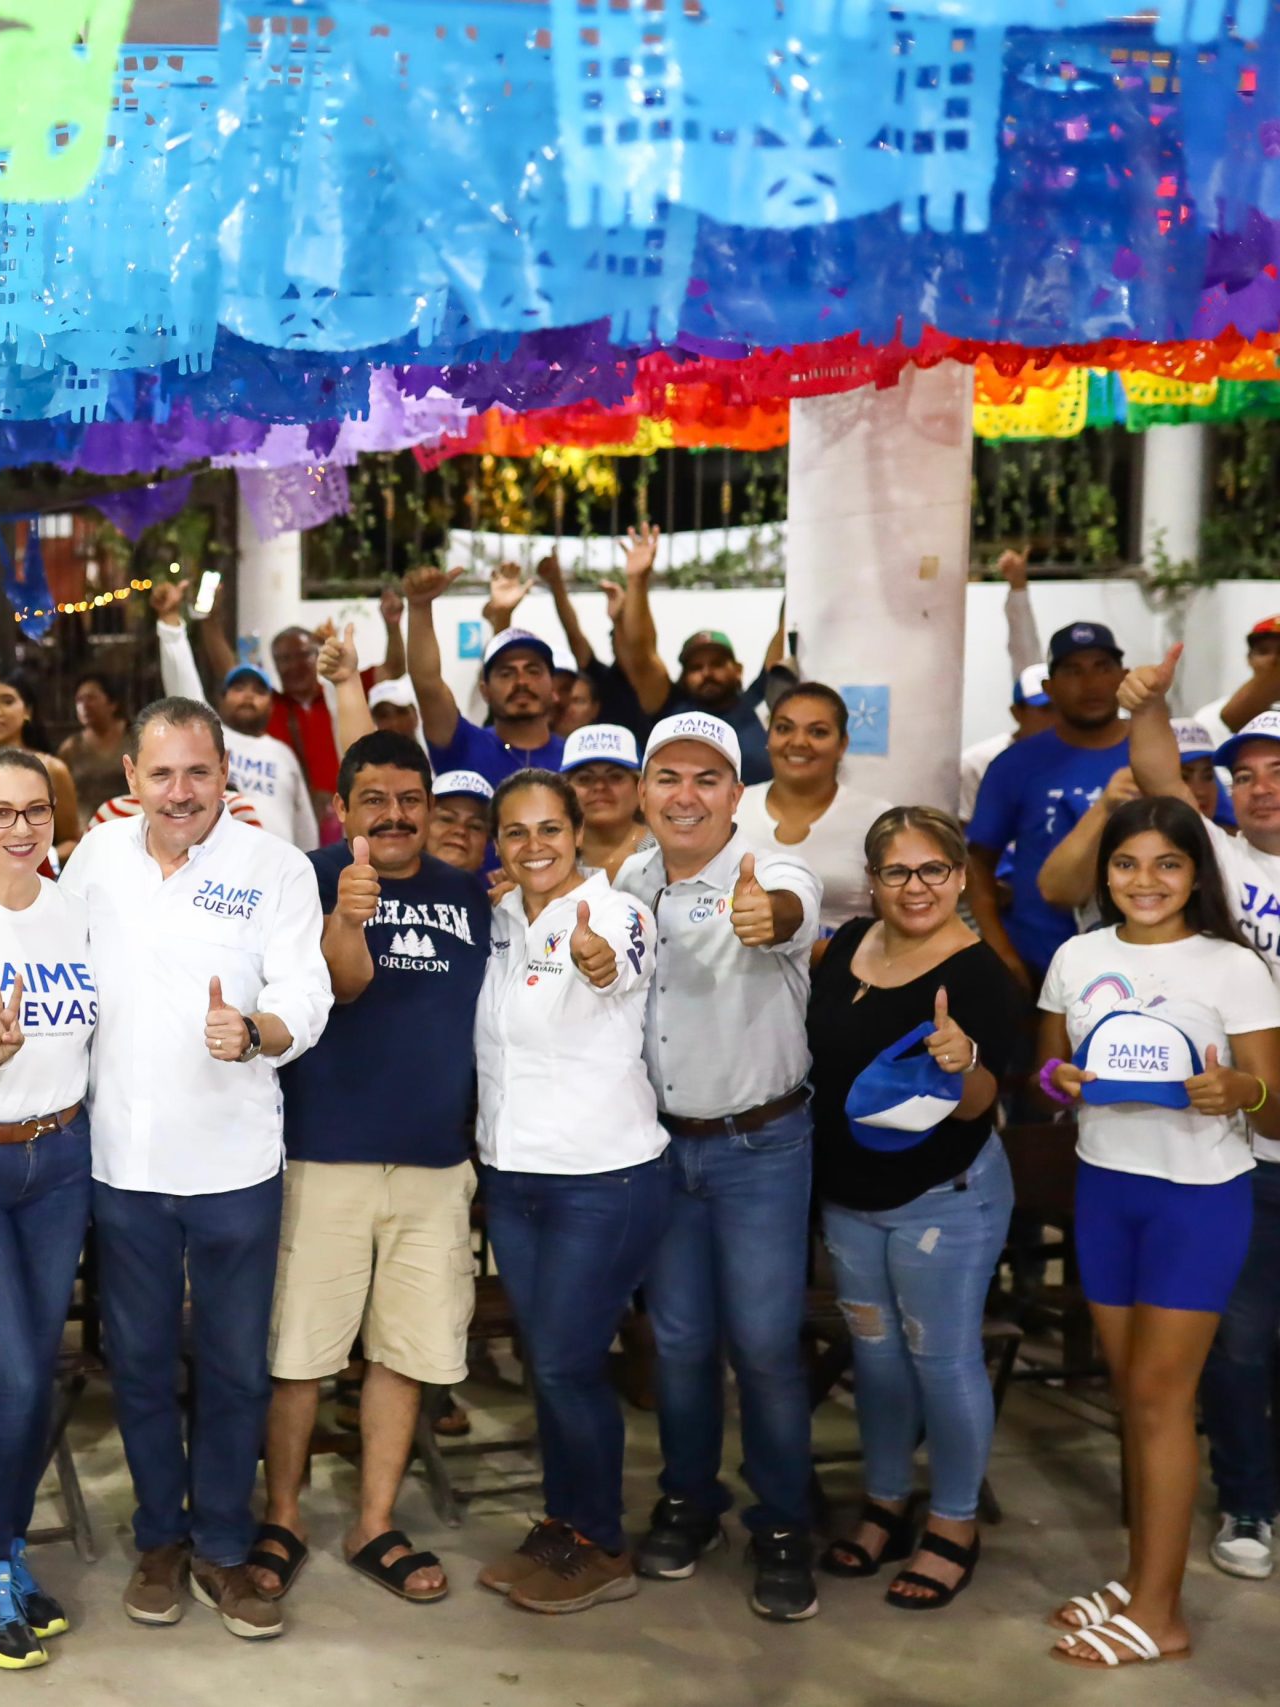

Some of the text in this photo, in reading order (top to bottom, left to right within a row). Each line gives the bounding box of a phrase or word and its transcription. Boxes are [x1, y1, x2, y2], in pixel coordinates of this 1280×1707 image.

[673, 724, 724, 743] CUEVAS
[677, 718, 725, 736] JAIME
[578, 742, 621, 751] CUEVAS
[580, 732, 621, 744] JAIME
[198, 879, 263, 907] JAIME
[193, 895, 253, 920] CUEVAS
[378, 955, 450, 972] OREGON
[1108, 1044, 1170, 1060] JAIME
[1108, 1058, 1169, 1072] CUEVAS
